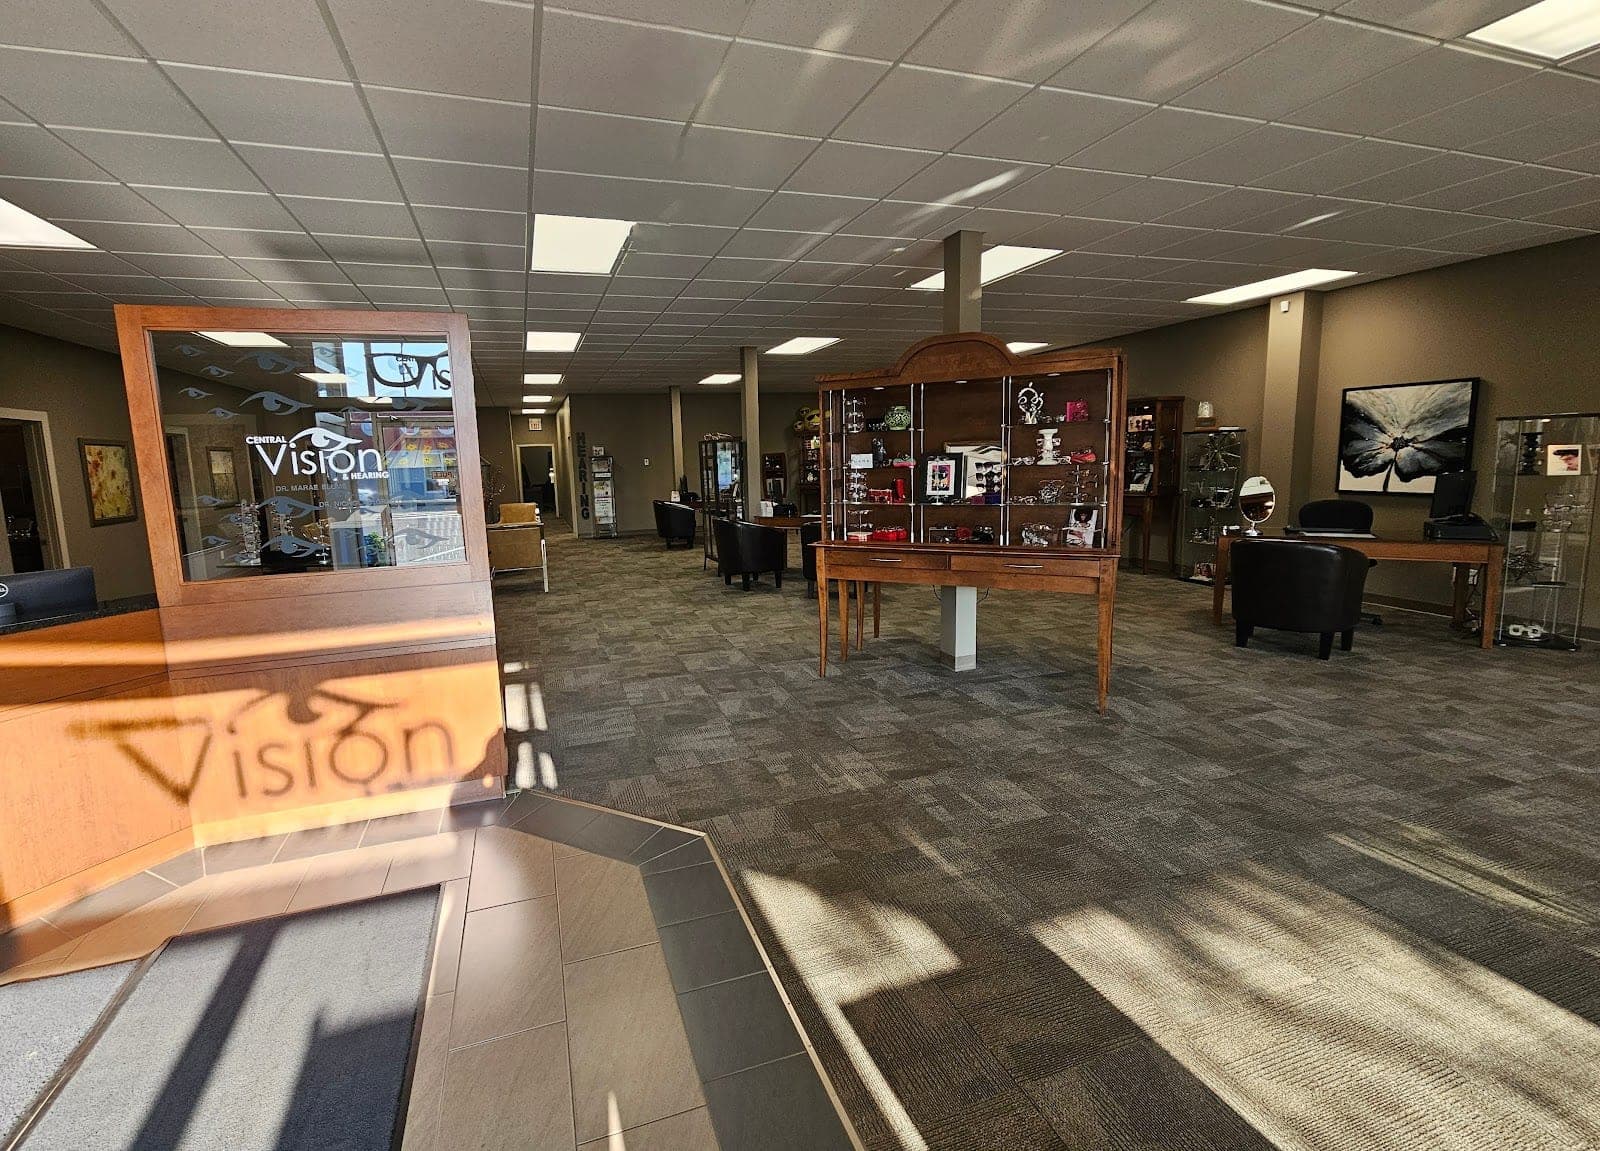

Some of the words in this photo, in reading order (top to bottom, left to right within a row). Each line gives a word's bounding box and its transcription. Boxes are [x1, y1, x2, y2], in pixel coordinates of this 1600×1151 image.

[246, 435, 287, 444] CENTRAL
[255, 442, 383, 476] Vision
[351, 471, 390, 479] HEARING
[576, 432, 590, 520] HEARING
